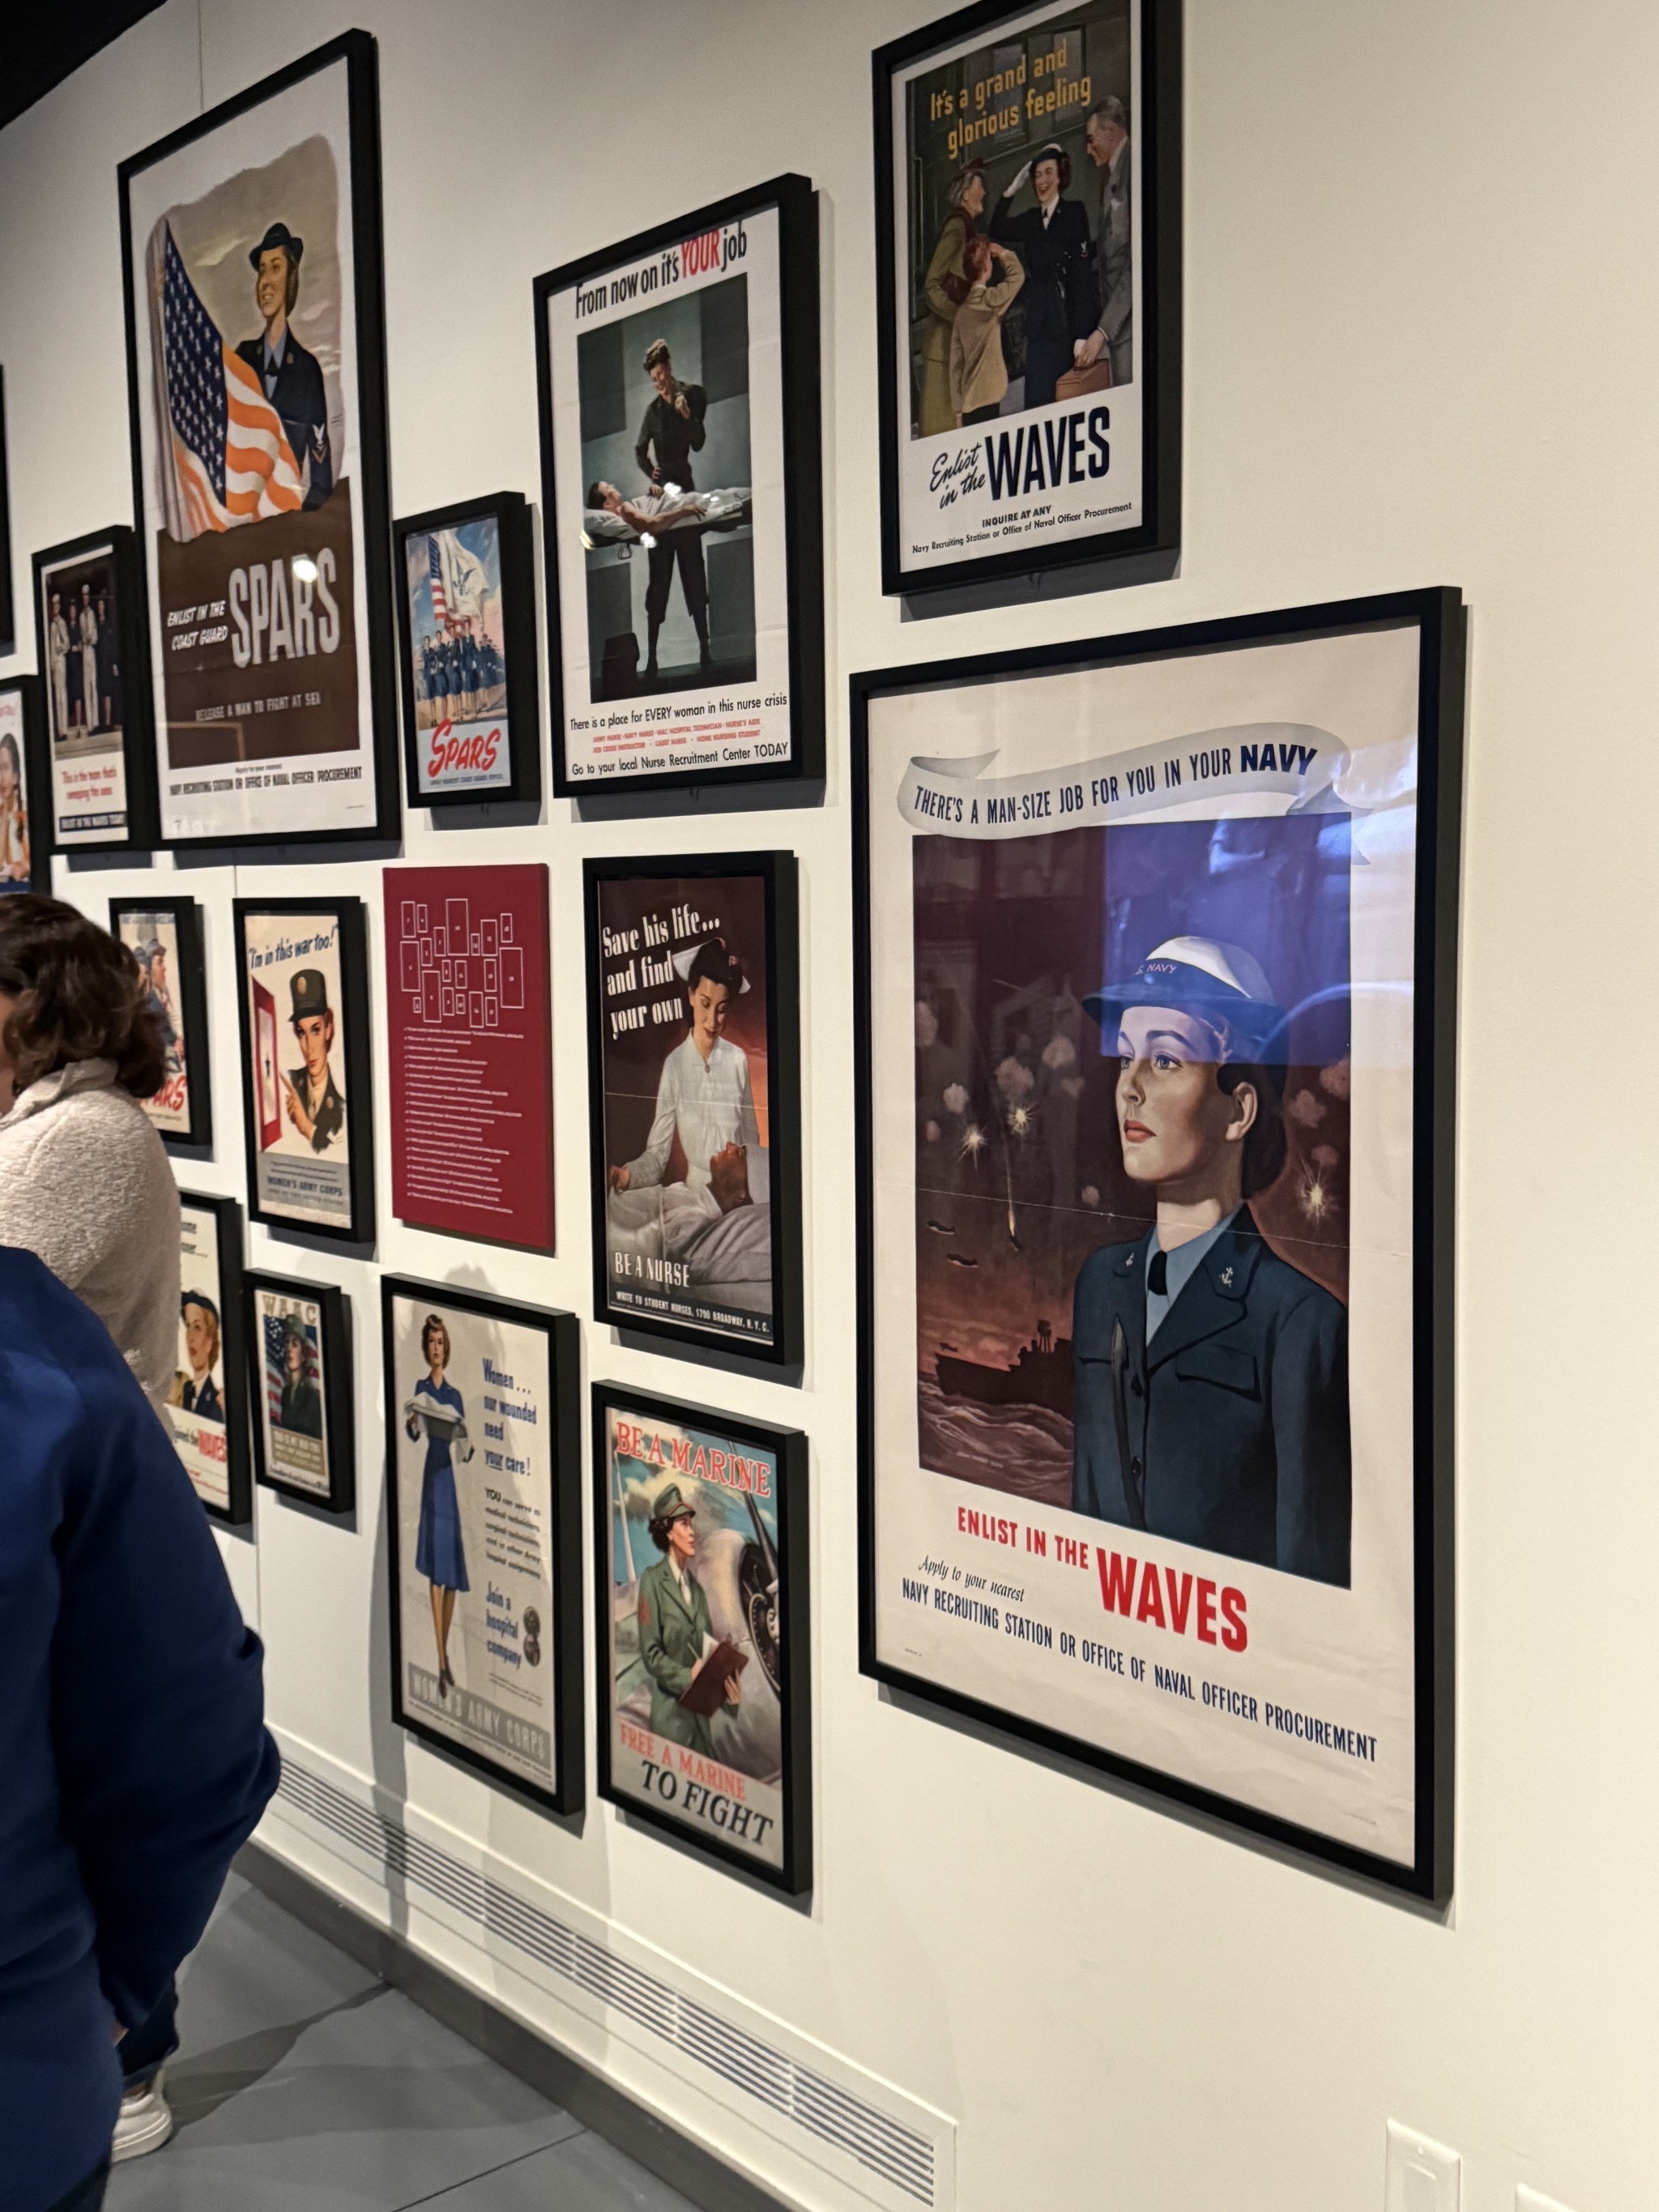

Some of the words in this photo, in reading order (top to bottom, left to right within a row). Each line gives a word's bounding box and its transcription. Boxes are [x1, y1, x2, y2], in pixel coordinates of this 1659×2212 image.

[932, 91, 953, 121] It's
[959, 88, 968, 109] a
[975, 54, 1026, 110] grand
[1033, 37, 1067, 78] and
[948, 105, 1019, 160] glorious
[1026, 76, 1091, 119] feeling
[575, 283, 607, 318] From
[611, 272, 638, 305] now
[641, 265, 658, 294] on
[662, 251, 679, 287] it's
[681, 228, 720, 279] YOUR
[721, 220, 747, 272] job
[930, 442, 982, 492] Enlist
[940, 485, 957, 509] in
[962, 467, 986, 495] the
[985, 406, 1110, 501] WAVES
[912, 545, 929, 553] Navy
[932, 537, 964, 549] Recruiting
[966, 532, 990, 543] Station
[1003, 525, 1022, 536] Office
[1025, 522, 1031, 531] of
[1034, 516, 1055, 529] Naval
[1058, 514, 1081, 524] Officer
[1085, 502, 1132, 519] Procurement
[983, 513, 1018, 527] INQUIRE
[1021, 509, 1031, 519] AT
[1033, 505, 1051, 517] ANY
[167, 607, 196, 627] ENLIST
[196, 604, 208, 621] IN
[210, 600, 225, 617] THE
[172, 631, 198, 651] COAST
[199, 625, 228, 646] GUARD
[229, 548, 340, 668] SPARS
[254, 700, 264, 713] TO
[267, 696, 289, 711] FIGHT
[292, 694, 301, 708] AT
[305, 692, 322, 706] SEA
[570, 719, 589, 730] There
[591, 716, 597, 728] is
[599, 719, 605, 727] a
[608, 712, 629, 728] place
[631, 710, 642, 723] for
[645, 707, 672, 721] EVERY
[674, 706, 705, 718] woman
[708, 701, 715, 713] in
[719, 698, 734, 712] this
[737, 698, 761, 710] nurse
[765, 692, 787, 707] crisis
[428, 718, 501, 778] SPARS
[572, 763, 583, 775] Go
[587, 764, 595, 774] to
[599, 763, 615, 775] your
[619, 756, 638, 771] local
[641, 756, 665, 769] Nurse
[669, 750, 718, 766] Recruitment
[723, 748, 750, 761] Center
[754, 741, 788, 758] TODAY
[914, 785, 963, 823] THERE'S
[970, 799, 979, 824] A
[987, 791, 1051, 824] MAN-SIZE
[1060, 785, 1083, 813] JOB
[1091, 775, 1120, 806] FOR
[1126, 761, 1155, 797] YOU
[1164, 758, 1181, 788] IN
[1189, 748, 1231, 781] YOUR
[1240, 744, 1318, 775] NAVY
[603, 926, 639, 958] Save
[642, 913, 669, 948] his
[672, 903, 720, 939] life...
[608, 959, 637, 997] and
[641, 950, 674, 988] find
[1146, 963, 1177, 974] NAVY
[610, 1006, 647, 1040] your
[652, 997, 683, 1024] own
[615, 1252, 631, 1275] BE
[635, 1255, 642, 1278] A
[646, 1258, 690, 1287] NURSE
[616, 1290, 633, 1303] WRITE
[635, 1295, 642, 1305] TO
[644, 1296, 669, 1310] STUDENT
[616, 1421, 644, 1458] BE
[649, 1433, 665, 1467] A
[672, 1437, 770, 1498] MARINE
[484, 1487, 501, 1502] YOU
[918, 1555, 949, 1581] Apply
[952, 1565, 961, 1581] to
[965, 1573, 987, 1590] your
[990, 1581, 1025, 1603] nearest
[957, 1505, 1017, 1548] ENLIST
[1026, 1527, 1046, 1557] IN
[1055, 1535, 1089, 1570] THE
[1095, 1546, 1247, 1653] WAVES
[486, 1608, 519, 1639] hospital
[487, 1640, 522, 1670] company
[902, 1578, 928, 1606] NAVY
[935, 1588, 999, 1629] RECRUITING
[1005, 1612, 1051, 1649] STATION
[1060, 1632, 1076, 1658] OR
[1082, 1639, 1124, 1676] OFFICE
[1131, 1656, 1145, 1683] OF
[1154, 1664, 1196, 1701] NAVAL
[1202, 1680, 1258, 1723] OFFICER
[1265, 1702, 1377, 1763] PROCUREMENT
[621, 1723, 655, 1758] FREE
[661, 1744, 673, 1768] A
[679, 1749, 746, 1802] MARINE
[642, 1760, 677, 1800] TO
[682, 1780, 774, 1846] FIGHT
